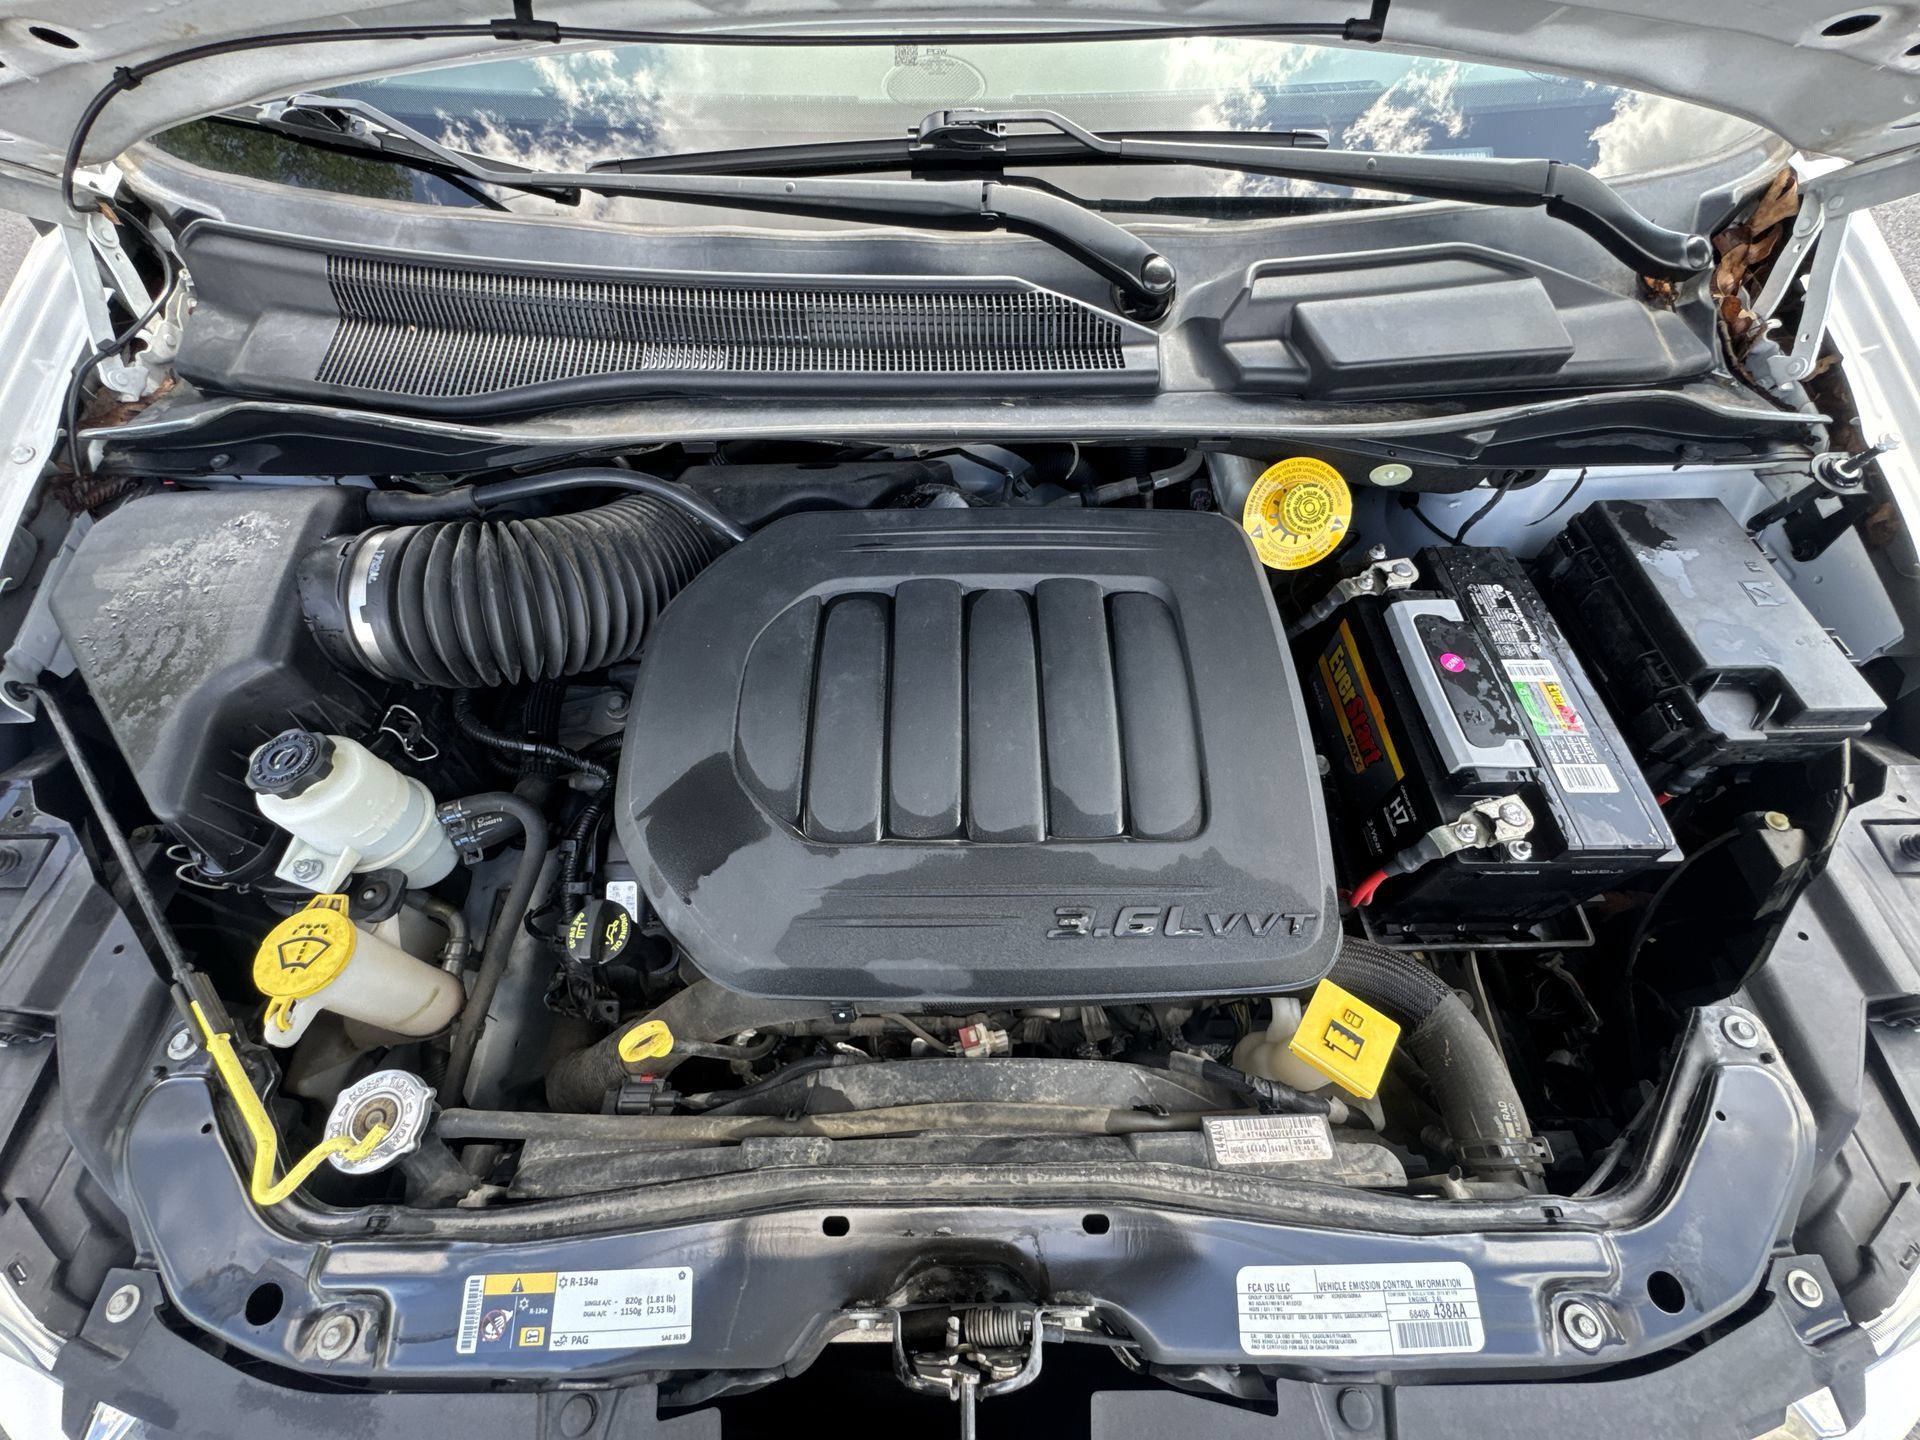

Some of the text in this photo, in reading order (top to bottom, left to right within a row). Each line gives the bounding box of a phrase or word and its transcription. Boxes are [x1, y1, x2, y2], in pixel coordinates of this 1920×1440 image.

[1328, 644, 1383, 767] EverStart
[1346, 733, 1362, 769] MAXX
[1389, 796, 1410, 825] H7
[1047, 906, 1316, 938] 3.6L VVT
[610, 913, 629, 952] ENGINE OIL
[1498, 1101, 1512, 1123] RAD
[570, 1276, 598, 1286] R-134a
[1247, 1282, 1290, 1292] FCA US LLC
[1319, 1279, 1461, 1291] VEHICLE EMISSION CONTROL INFORMATION
[625, 1297, 642, 1306] 820g
[646, 1296, 664, 1305] (1.81
[665, 1295, 676, 1304] lb)
[620, 1307, 642, 1317] 1150g
[646, 1306, 664, 1316] (2.53
[666, 1305, 676, 1315] lb)
[1409, 1303, 1467, 1319] 68406 438AA
[571, 1336, 589, 1345] PAG
